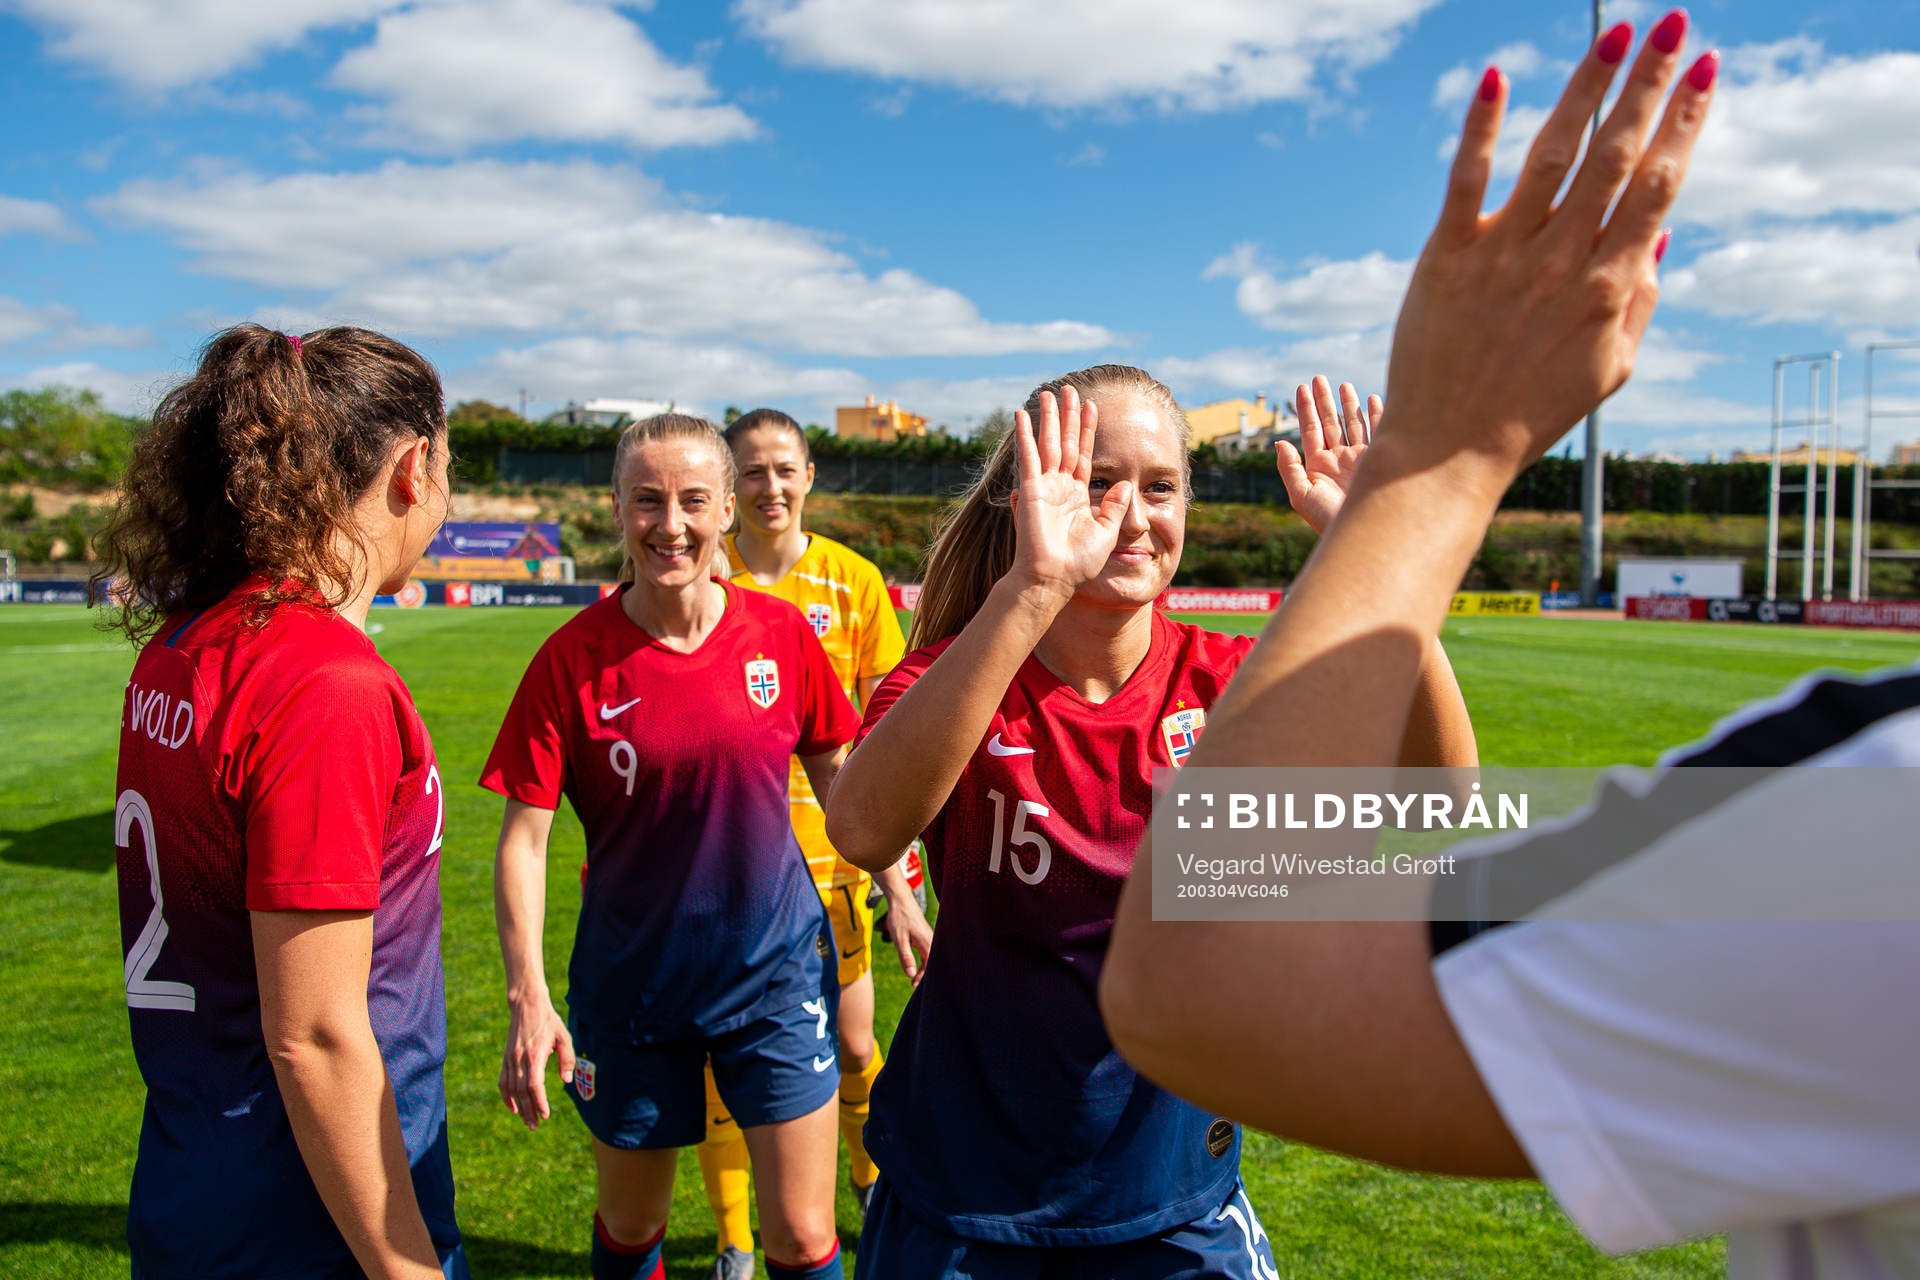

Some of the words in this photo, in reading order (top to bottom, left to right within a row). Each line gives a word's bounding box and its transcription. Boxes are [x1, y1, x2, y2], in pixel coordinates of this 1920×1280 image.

[470, 584, 503, 605] BPI
[1167, 592, 1270, 610] CONTINENTE
[1480, 595, 1533, 614] Hertz
[131, 683, 193, 749] WOLD
[609, 740, 637, 796] 9
[987, 788, 1051, 885] 15
[114, 789, 196, 1012] 2
[837, 885, 857, 931] 1
